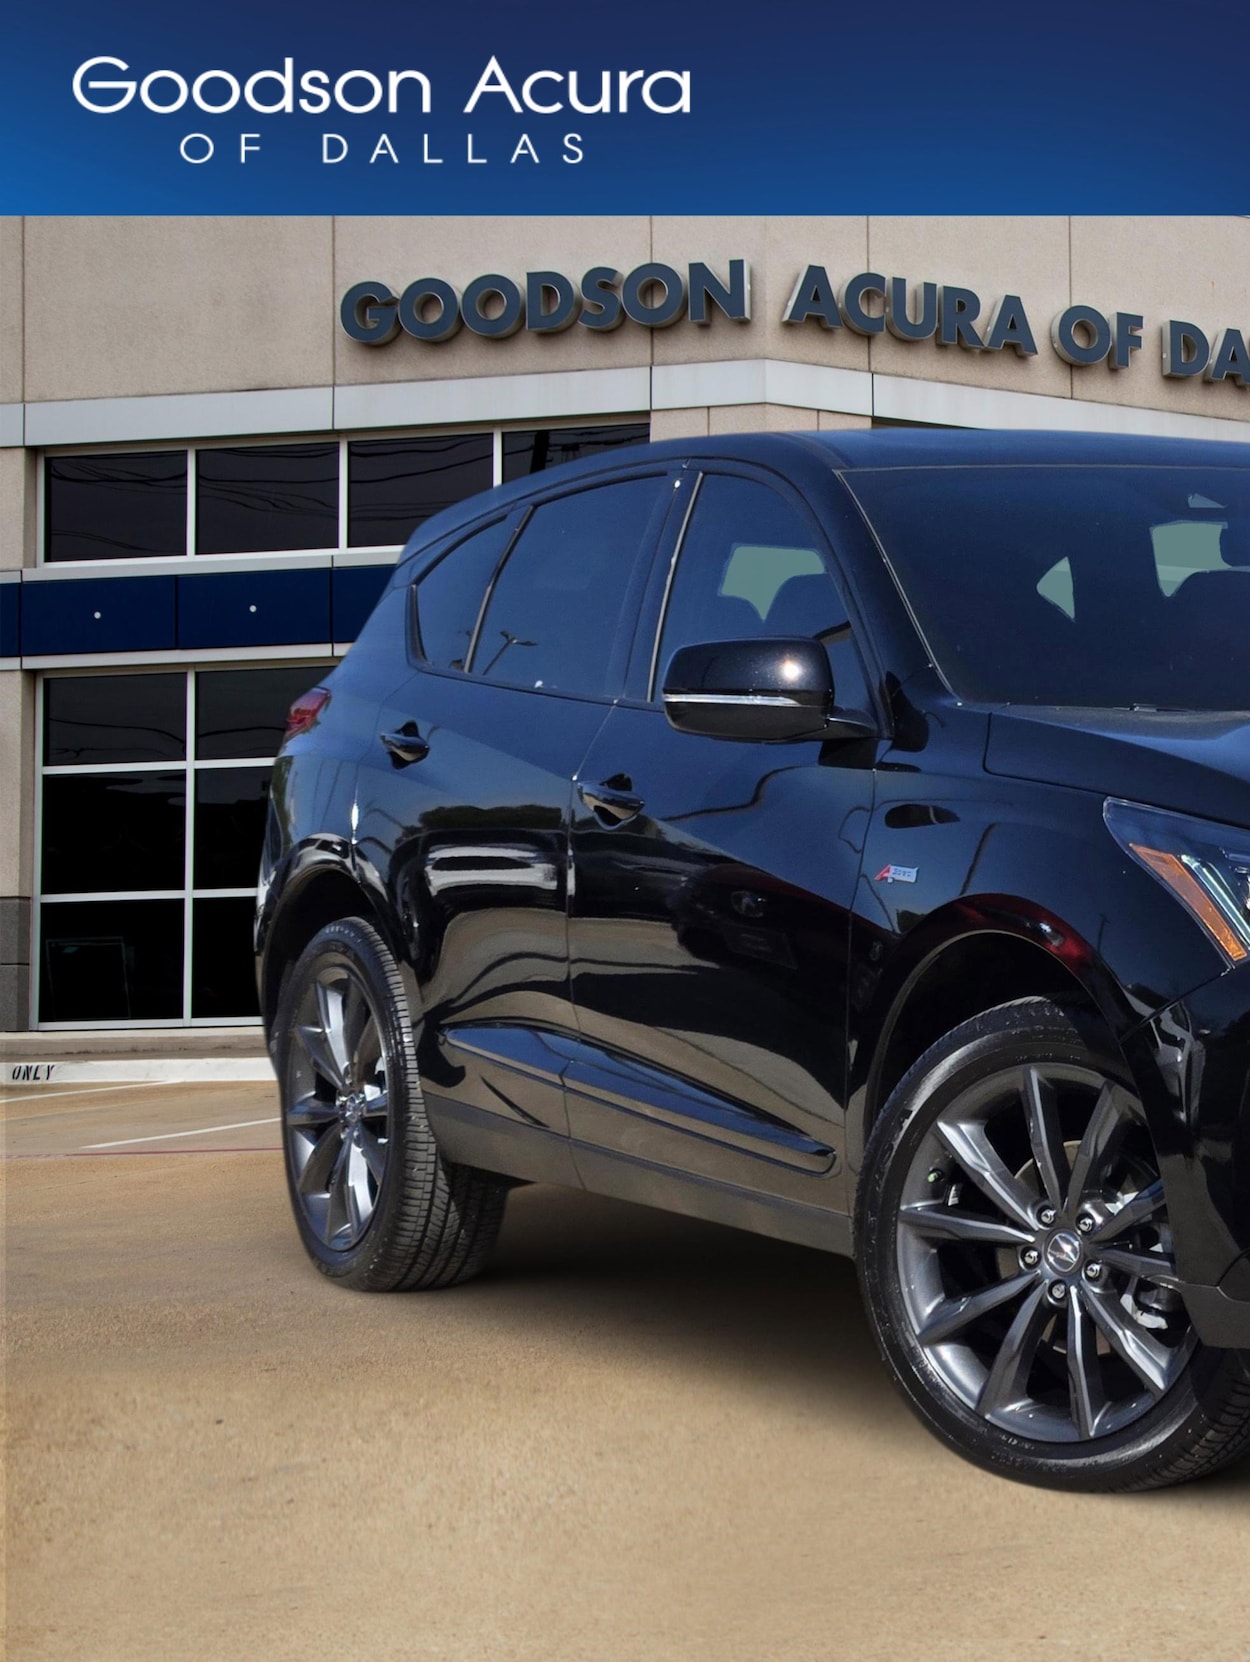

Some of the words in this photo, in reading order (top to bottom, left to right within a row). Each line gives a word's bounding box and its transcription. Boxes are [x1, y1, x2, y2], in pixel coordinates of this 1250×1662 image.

[340, 259, 751, 346] GOODSON
[782, 265, 1038, 357] ACURA
[1051, 305, 1144, 366] OF
[12, 1064, 55, 1081] ONLY
